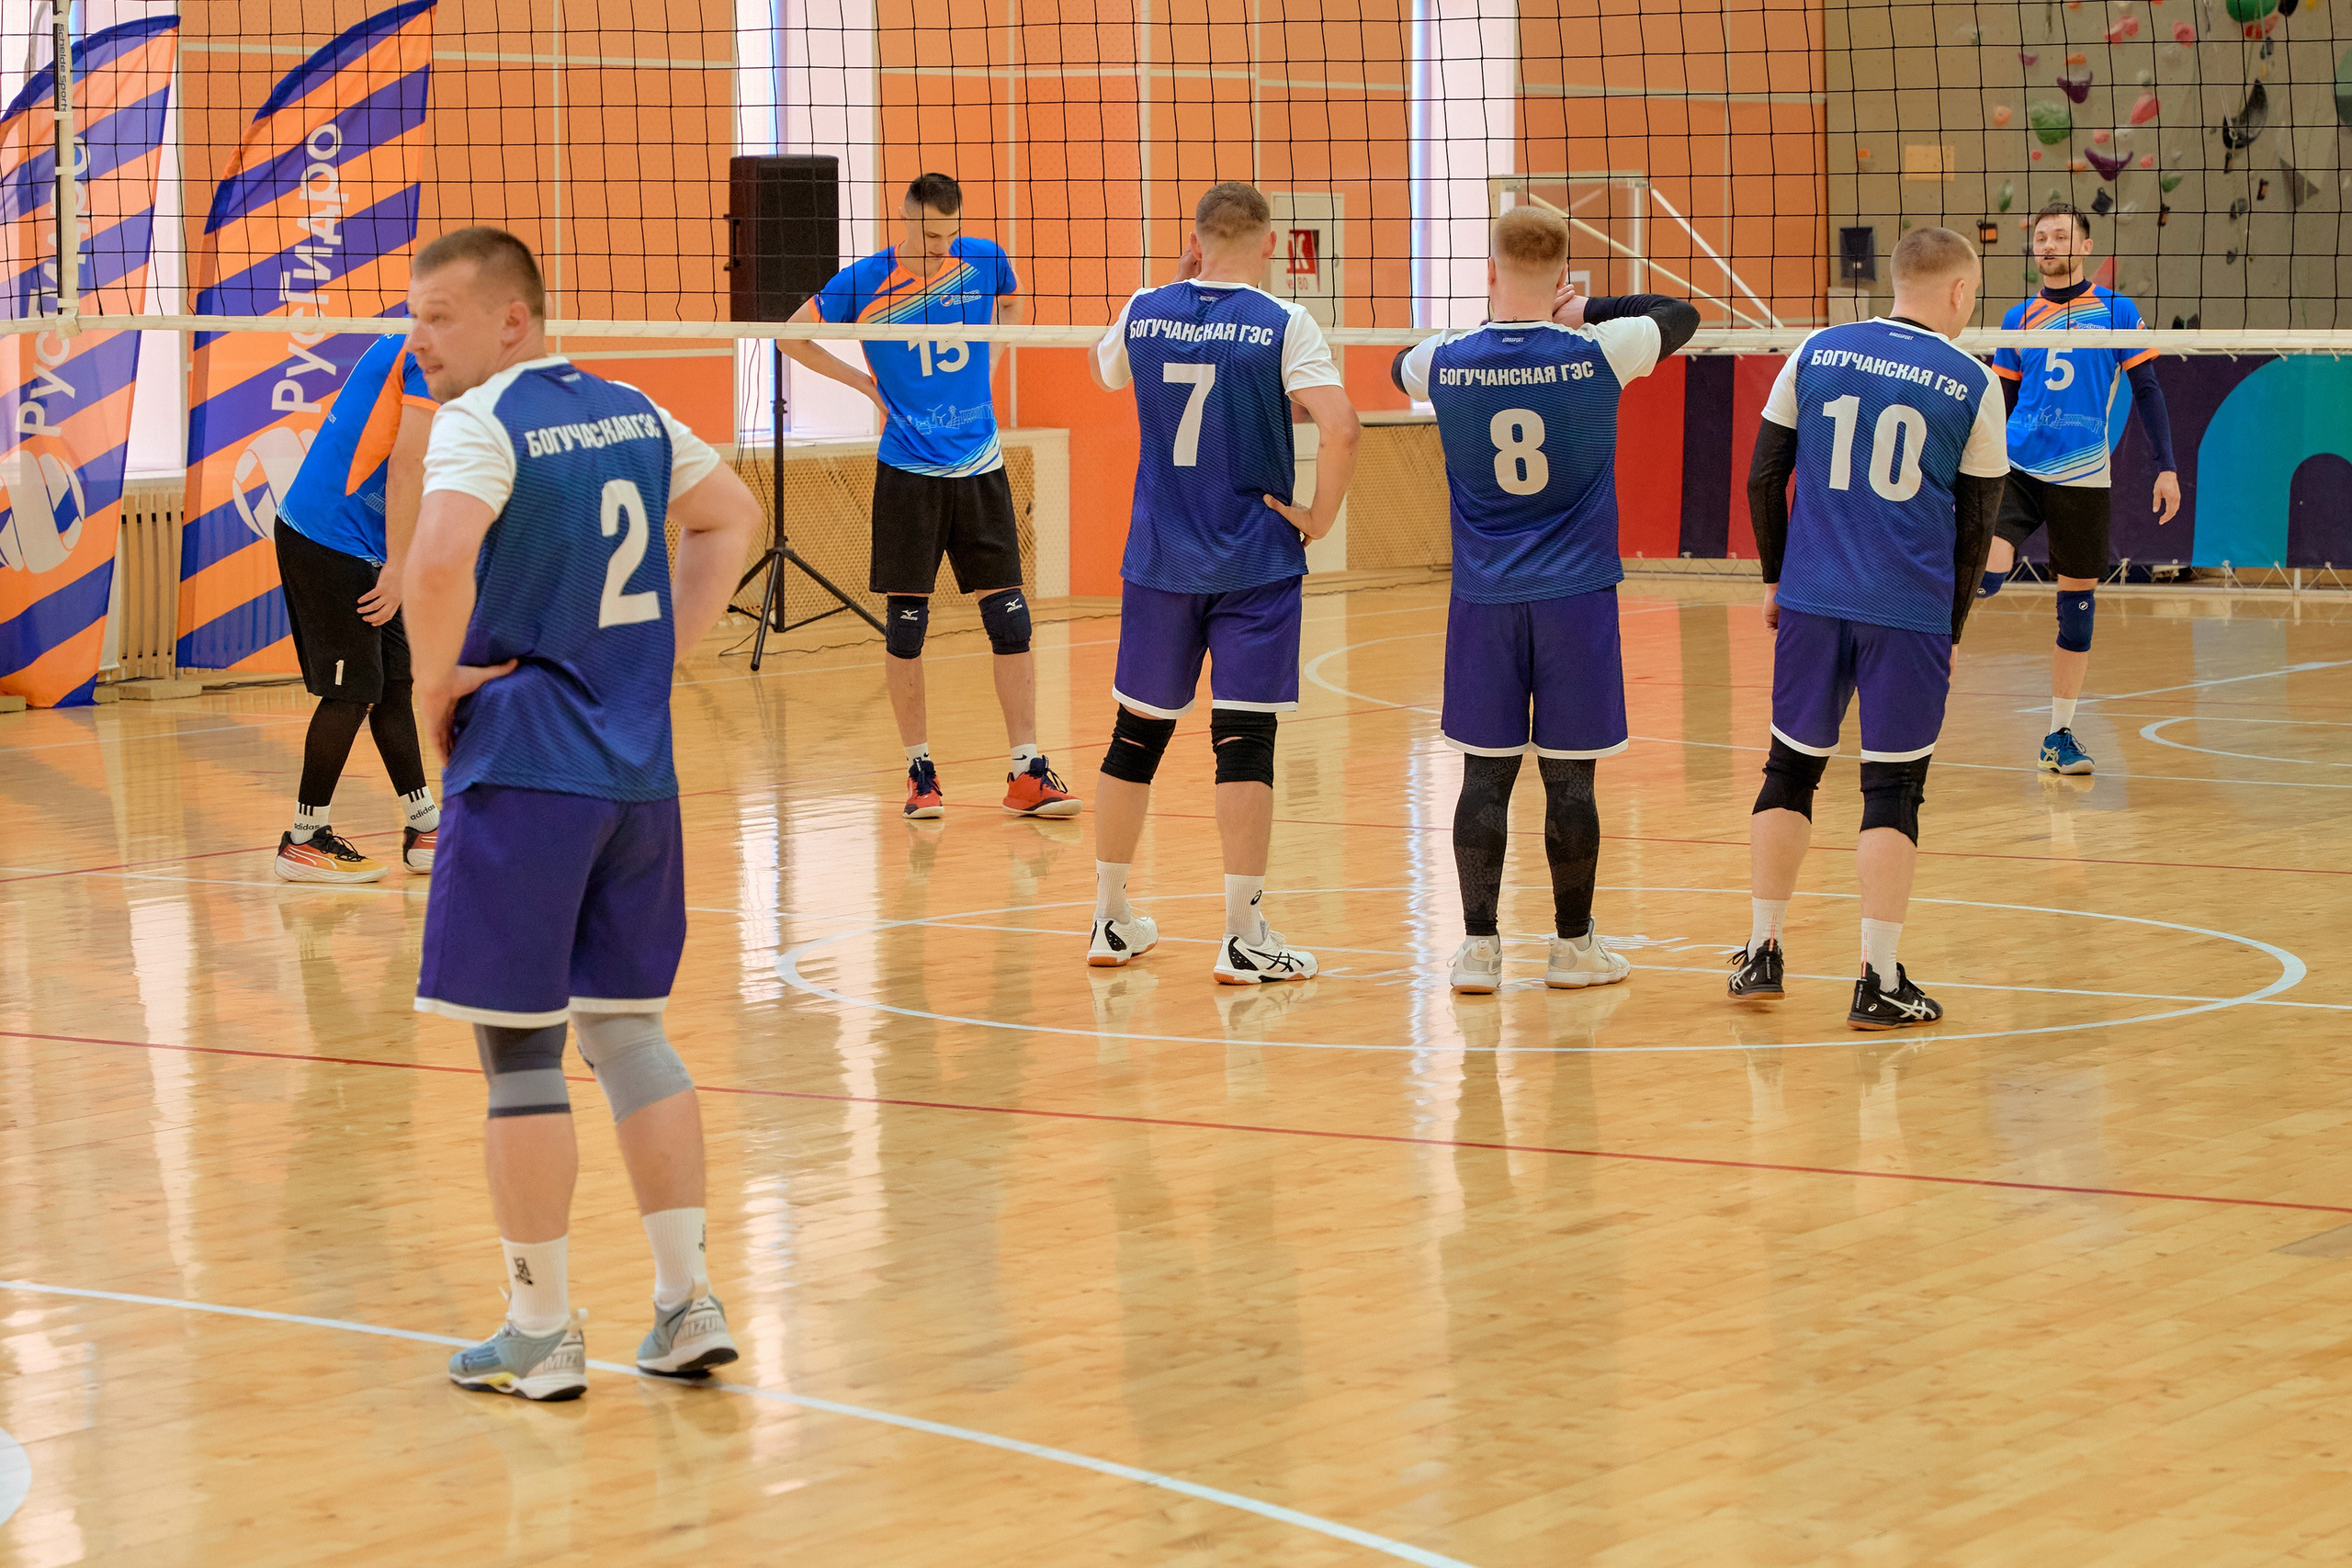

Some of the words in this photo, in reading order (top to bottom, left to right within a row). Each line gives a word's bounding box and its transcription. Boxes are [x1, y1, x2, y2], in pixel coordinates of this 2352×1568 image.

[907, 321, 969, 377] 15
[1130, 319, 1237, 343] БОГУЧАНСКАЯ
[1238, 324, 1273, 346] ГЭС
[1439, 366, 1557, 386] БОГУЧАНСКАЯ
[1560, 361, 1594, 382] ГЭС
[1810, 349, 1933, 386] БОГУЧАНСКАЯ
[1934, 374, 1968, 401] ГЭС
[2044, 347, 2075, 390] 5
[1163, 362, 1216, 467] 7
[1489, 408, 1549, 496] 8
[1823, 394, 1927, 502] 10
[598, 479, 662, 628] 2
[335, 660, 344, 685] 1
[294, 822, 320, 830] adidas
[410, 804, 435, 820] adidas
